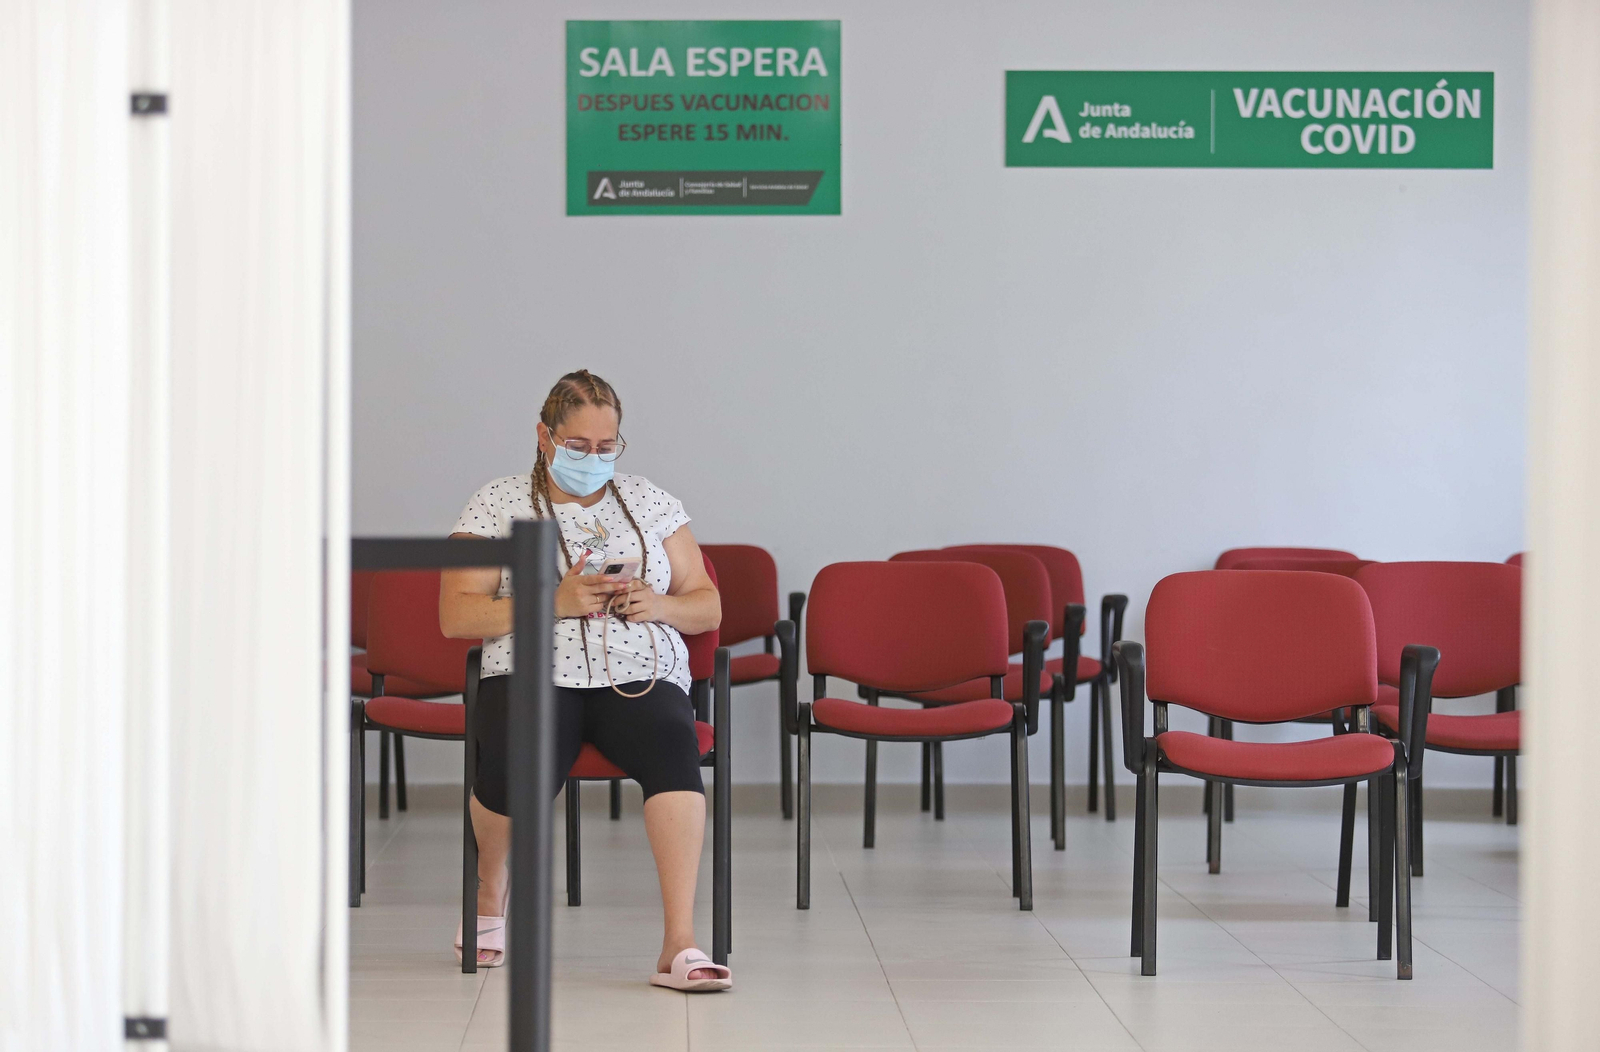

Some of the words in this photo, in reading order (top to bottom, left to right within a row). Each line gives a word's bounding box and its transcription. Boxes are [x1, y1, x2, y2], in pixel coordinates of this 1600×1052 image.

[579, 47, 675, 77] SALA
[686, 47, 829, 77] ESPERA
[577, 93, 675, 112] DESPUES
[680, 93, 831, 112] VACUNACION
[1233, 78, 1482, 119] VACUNACIÓN
[1078, 101, 1132, 118] Junta
[618, 124, 697, 141] ESPERE
[703, 124, 729, 141] 15
[736, 124, 790, 141] MIN.
[1078, 122, 1102, 139] de
[1104, 120, 1195, 140] Andalucía
[1300, 123, 1416, 155] COVID
[618, 180, 645, 189] Junta
[618, 189, 630, 197] de
